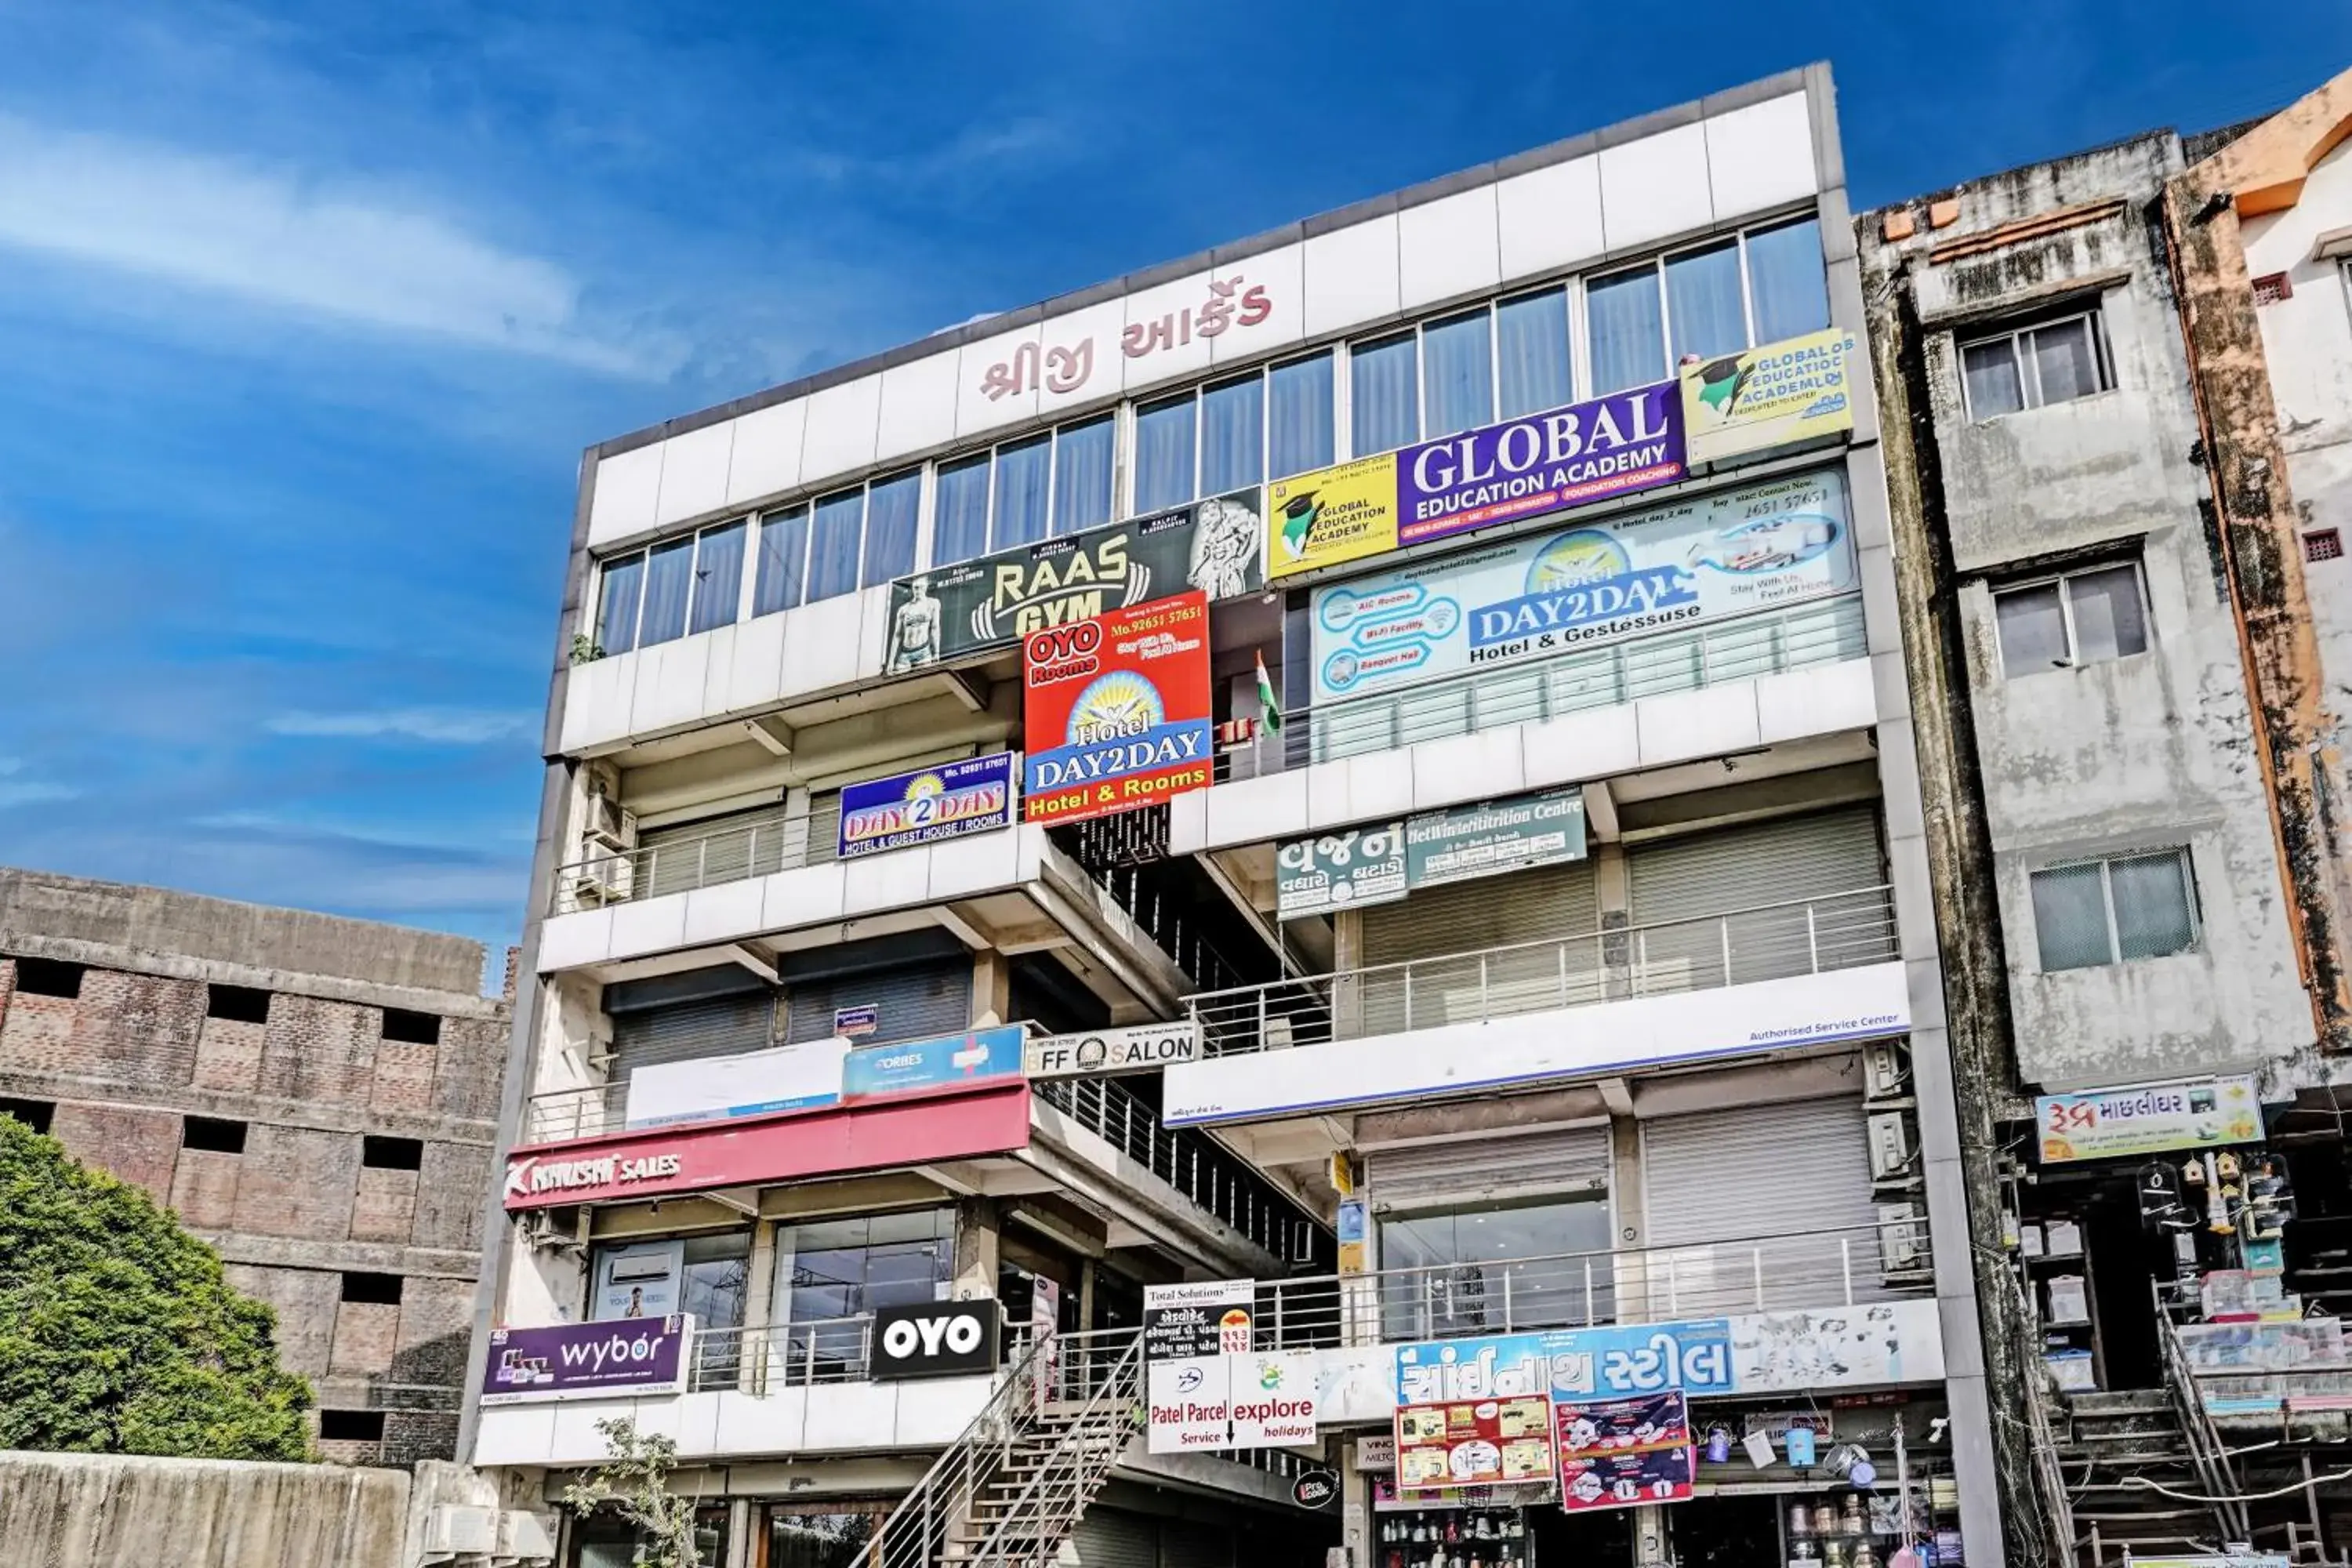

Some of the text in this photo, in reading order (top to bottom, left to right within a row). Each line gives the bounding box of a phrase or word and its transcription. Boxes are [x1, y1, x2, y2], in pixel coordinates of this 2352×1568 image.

[979, 274, 1272, 402] શ્રીજી આર્કેડ
[1759, 346, 1828, 372] GLOBAL
[1414, 393, 1668, 494] GLOBAL
[1417, 442, 1668, 520] EDUCATION ACADEMY
[1566, 466, 1676, 499] FOUNDATION COACHING
[1316, 506, 1386, 530] EDUCATION
[1323, 499, 1370, 517] GLOBAL
[1312, 522, 1370, 543] ACADEMY
[995, 534, 1127, 612] RAAS
[1015, 590, 1102, 638] GYM
[1029, 622, 1099, 663] OYO
[1470, 640, 1529, 663] Hotel
[1539, 633, 1555, 649] &
[1031, 657, 1097, 685] Rooms
[1076, 710, 1150, 747] Hotel
[1036, 730, 1203, 789] DAY2DAY
[1029, 789, 1090, 816] Hotel
[1098, 785, 1116, 802] &
[1124, 769, 1206, 797] Rooms
[915, 798, 931, 823] 2
[1535, 800, 1582, 820] Centre
[845, 840, 875, 855] HOTEL
[879, 839, 886, 849] &
[888, 829, 922, 847] GUEST
[924, 822, 958, 840] HOUSE
[965, 813, 1004, 831] ROOMS
[1750, 1014, 1899, 1041] Authorised Service Center
[1110, 1036, 1194, 1065] SALON
[619, 1154, 682, 1181] SALES
[1149, 1290, 1175, 1302] Total
[1178, 1287, 1225, 1299] Solutions
[884, 1315, 982, 1359] OYO
[1602, 1334, 1730, 1392] સ્ટીલ
[1152, 1399, 1227, 1425] Patel Parcel
[1234, 1398, 1313, 1423] explore
[1181, 1432, 1221, 1444] Service
[1264, 1425, 1313, 1438] holidays
